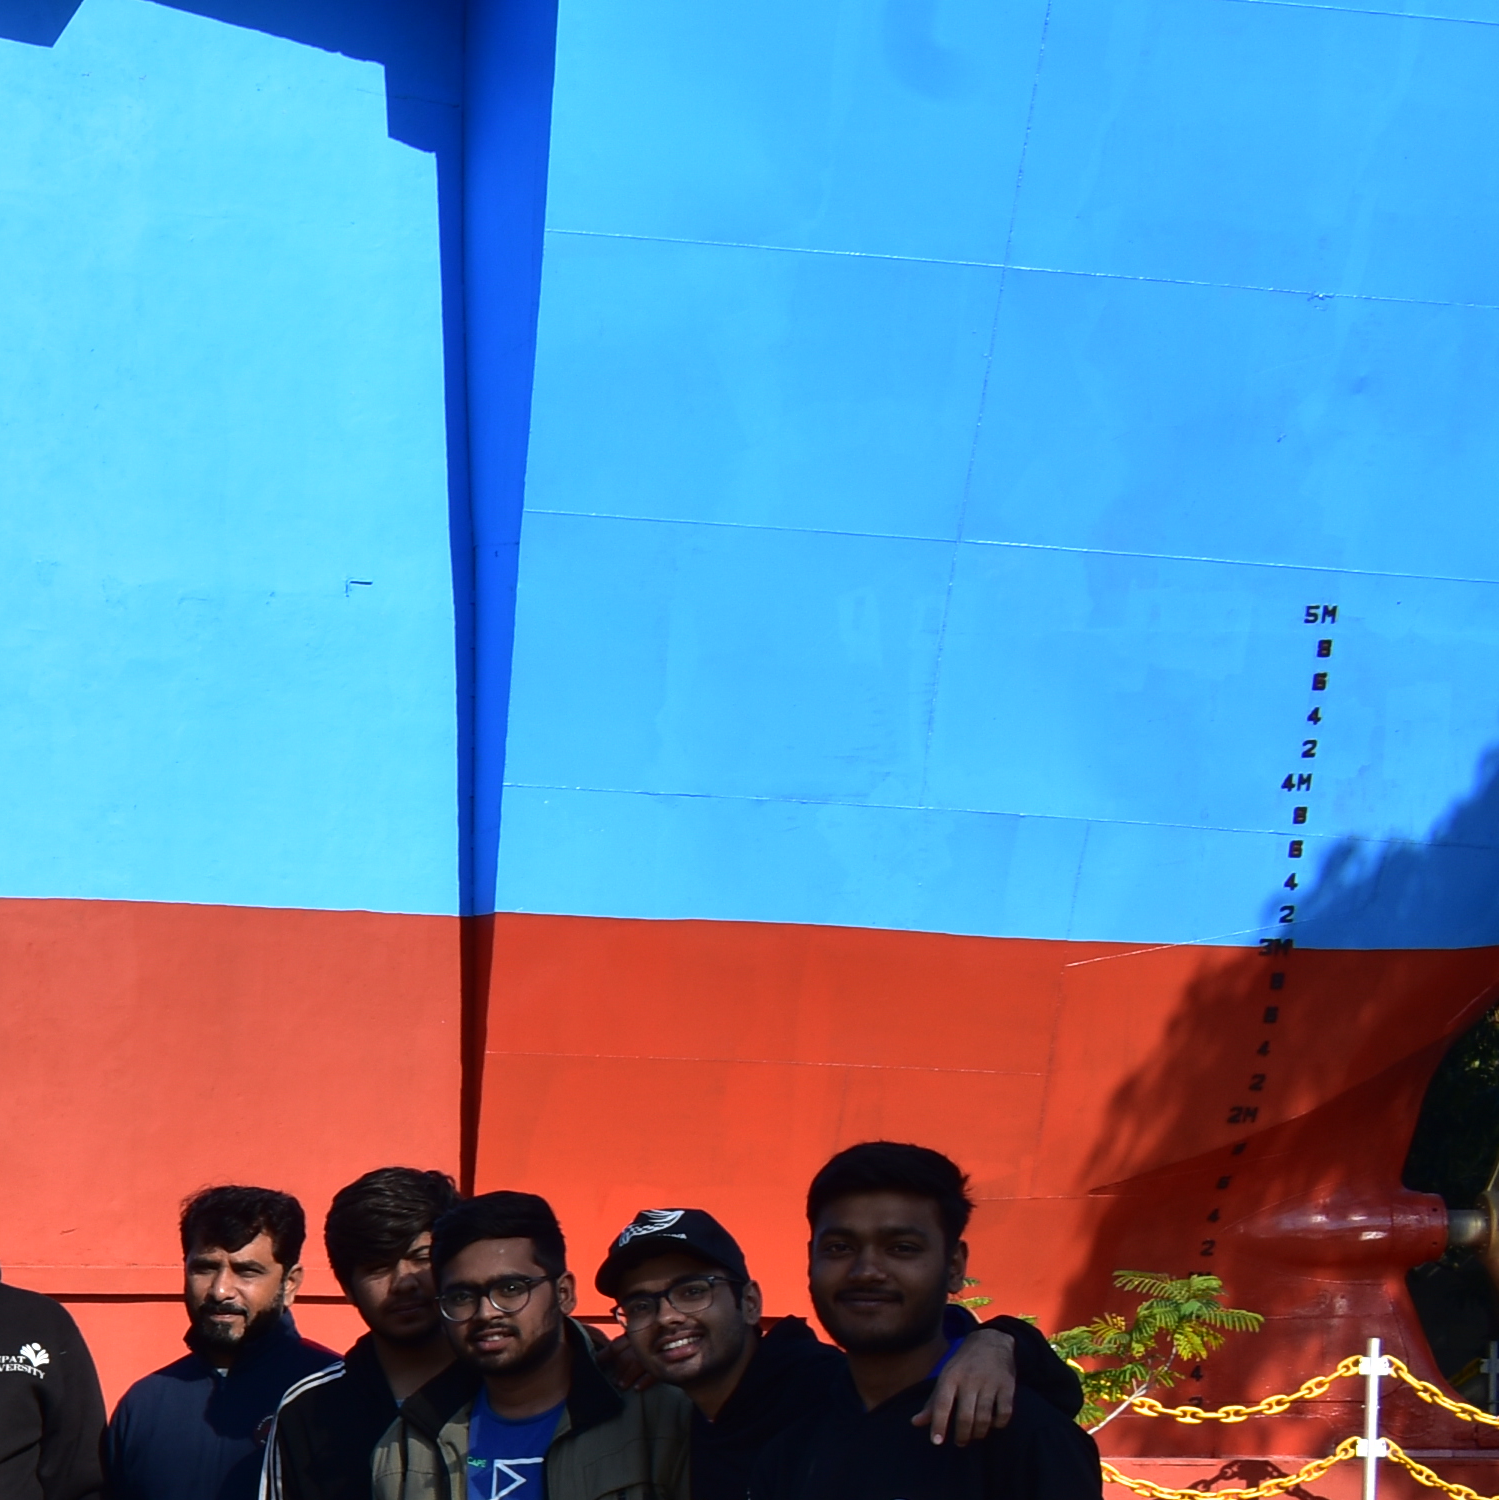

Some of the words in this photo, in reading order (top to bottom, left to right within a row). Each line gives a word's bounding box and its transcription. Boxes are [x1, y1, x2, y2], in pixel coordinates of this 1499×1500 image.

[1304, 605, 1337, 624] 5M
[1317, 639, 1332, 658] 8
[1312, 672, 1328, 691] 6
[1307, 707, 1321, 725] 4
[1301, 739, 1317, 758] 2
[1281, 773, 1312, 791] 4M
[1293, 806, 1307, 824] 8
[1284, 873, 1298, 891] 4
[1279, 905, 1295, 923] 2
[1259, 938, 1294, 956] 3M
[1249, 1074, 1266, 1091] 2
[1227, 1107, 1258, 1123] 2M
